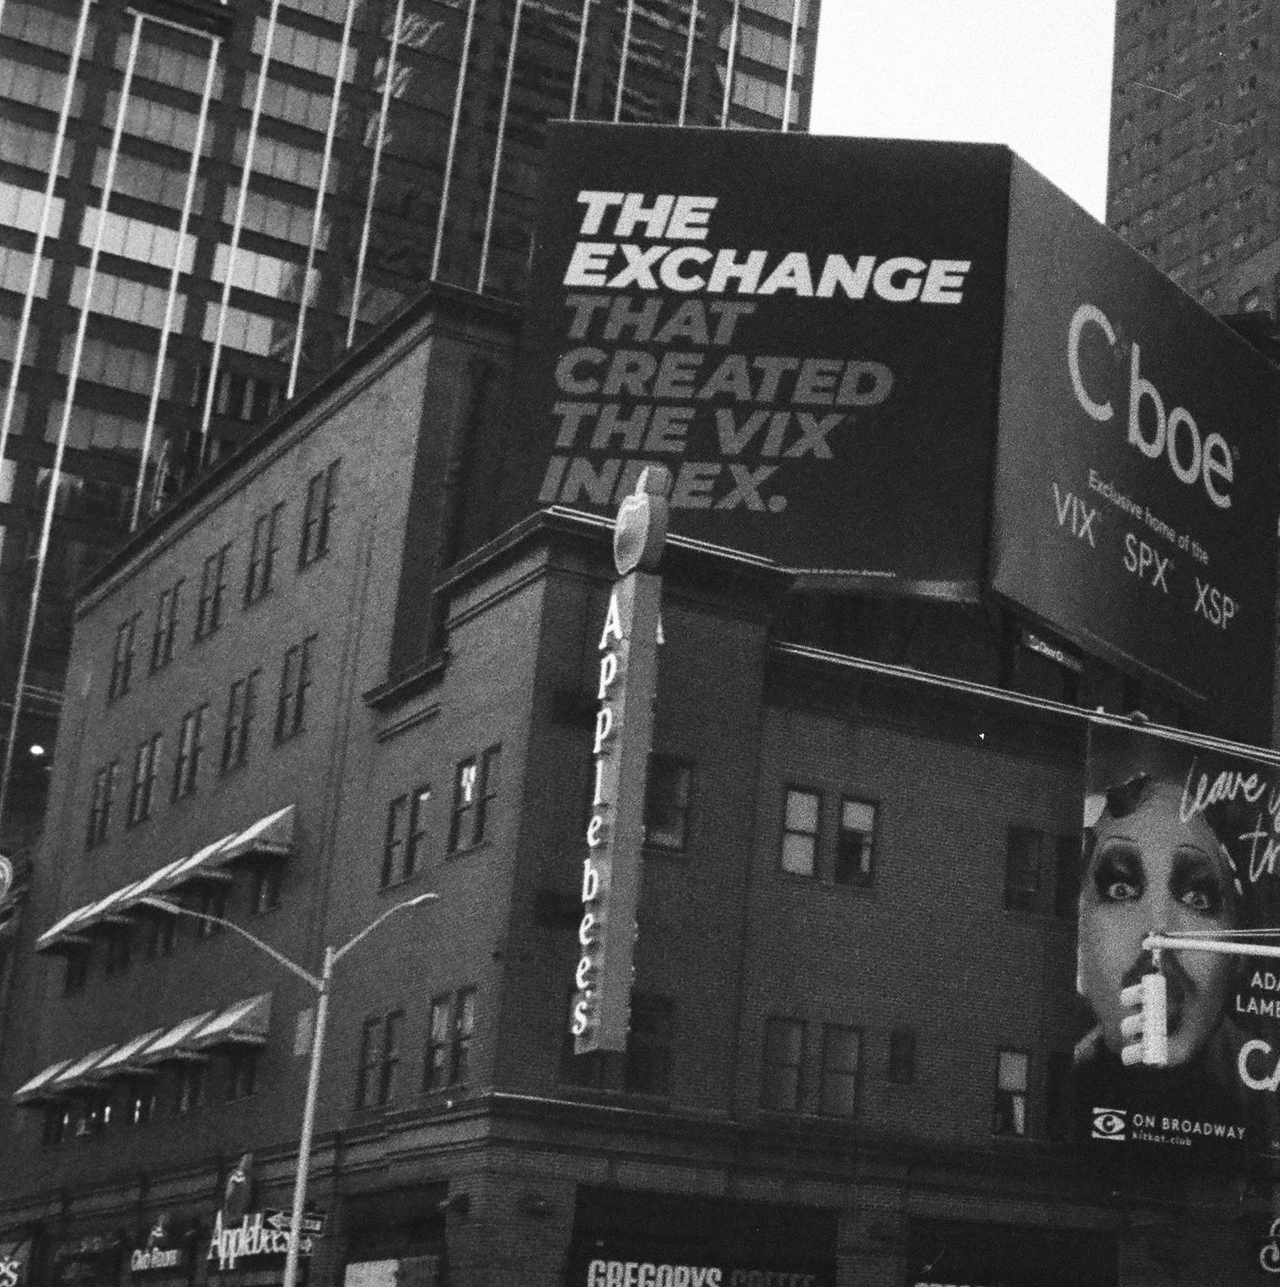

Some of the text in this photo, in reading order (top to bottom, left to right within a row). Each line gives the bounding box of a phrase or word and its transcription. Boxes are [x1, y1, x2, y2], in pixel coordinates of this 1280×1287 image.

[577, 190, 718, 240] THE
[563, 243, 971, 304] EXCHANGE
[565, 294, 756, 345] THAT
[554, 347, 893, 406] CREATED
[1067, 303, 1234, 509] Cboe
[553, 401, 845, 461] THE VIX
[1088, 468, 1209, 565] Exclusive home of the
[1053, 482, 1236, 630] VIX SPX XSP
[571, 593, 623, 1036] Applebee's
[1132, 1113, 1246, 1140] ON BROADWAY
[1132, 1129, 1192, 1147] kitkat.club
